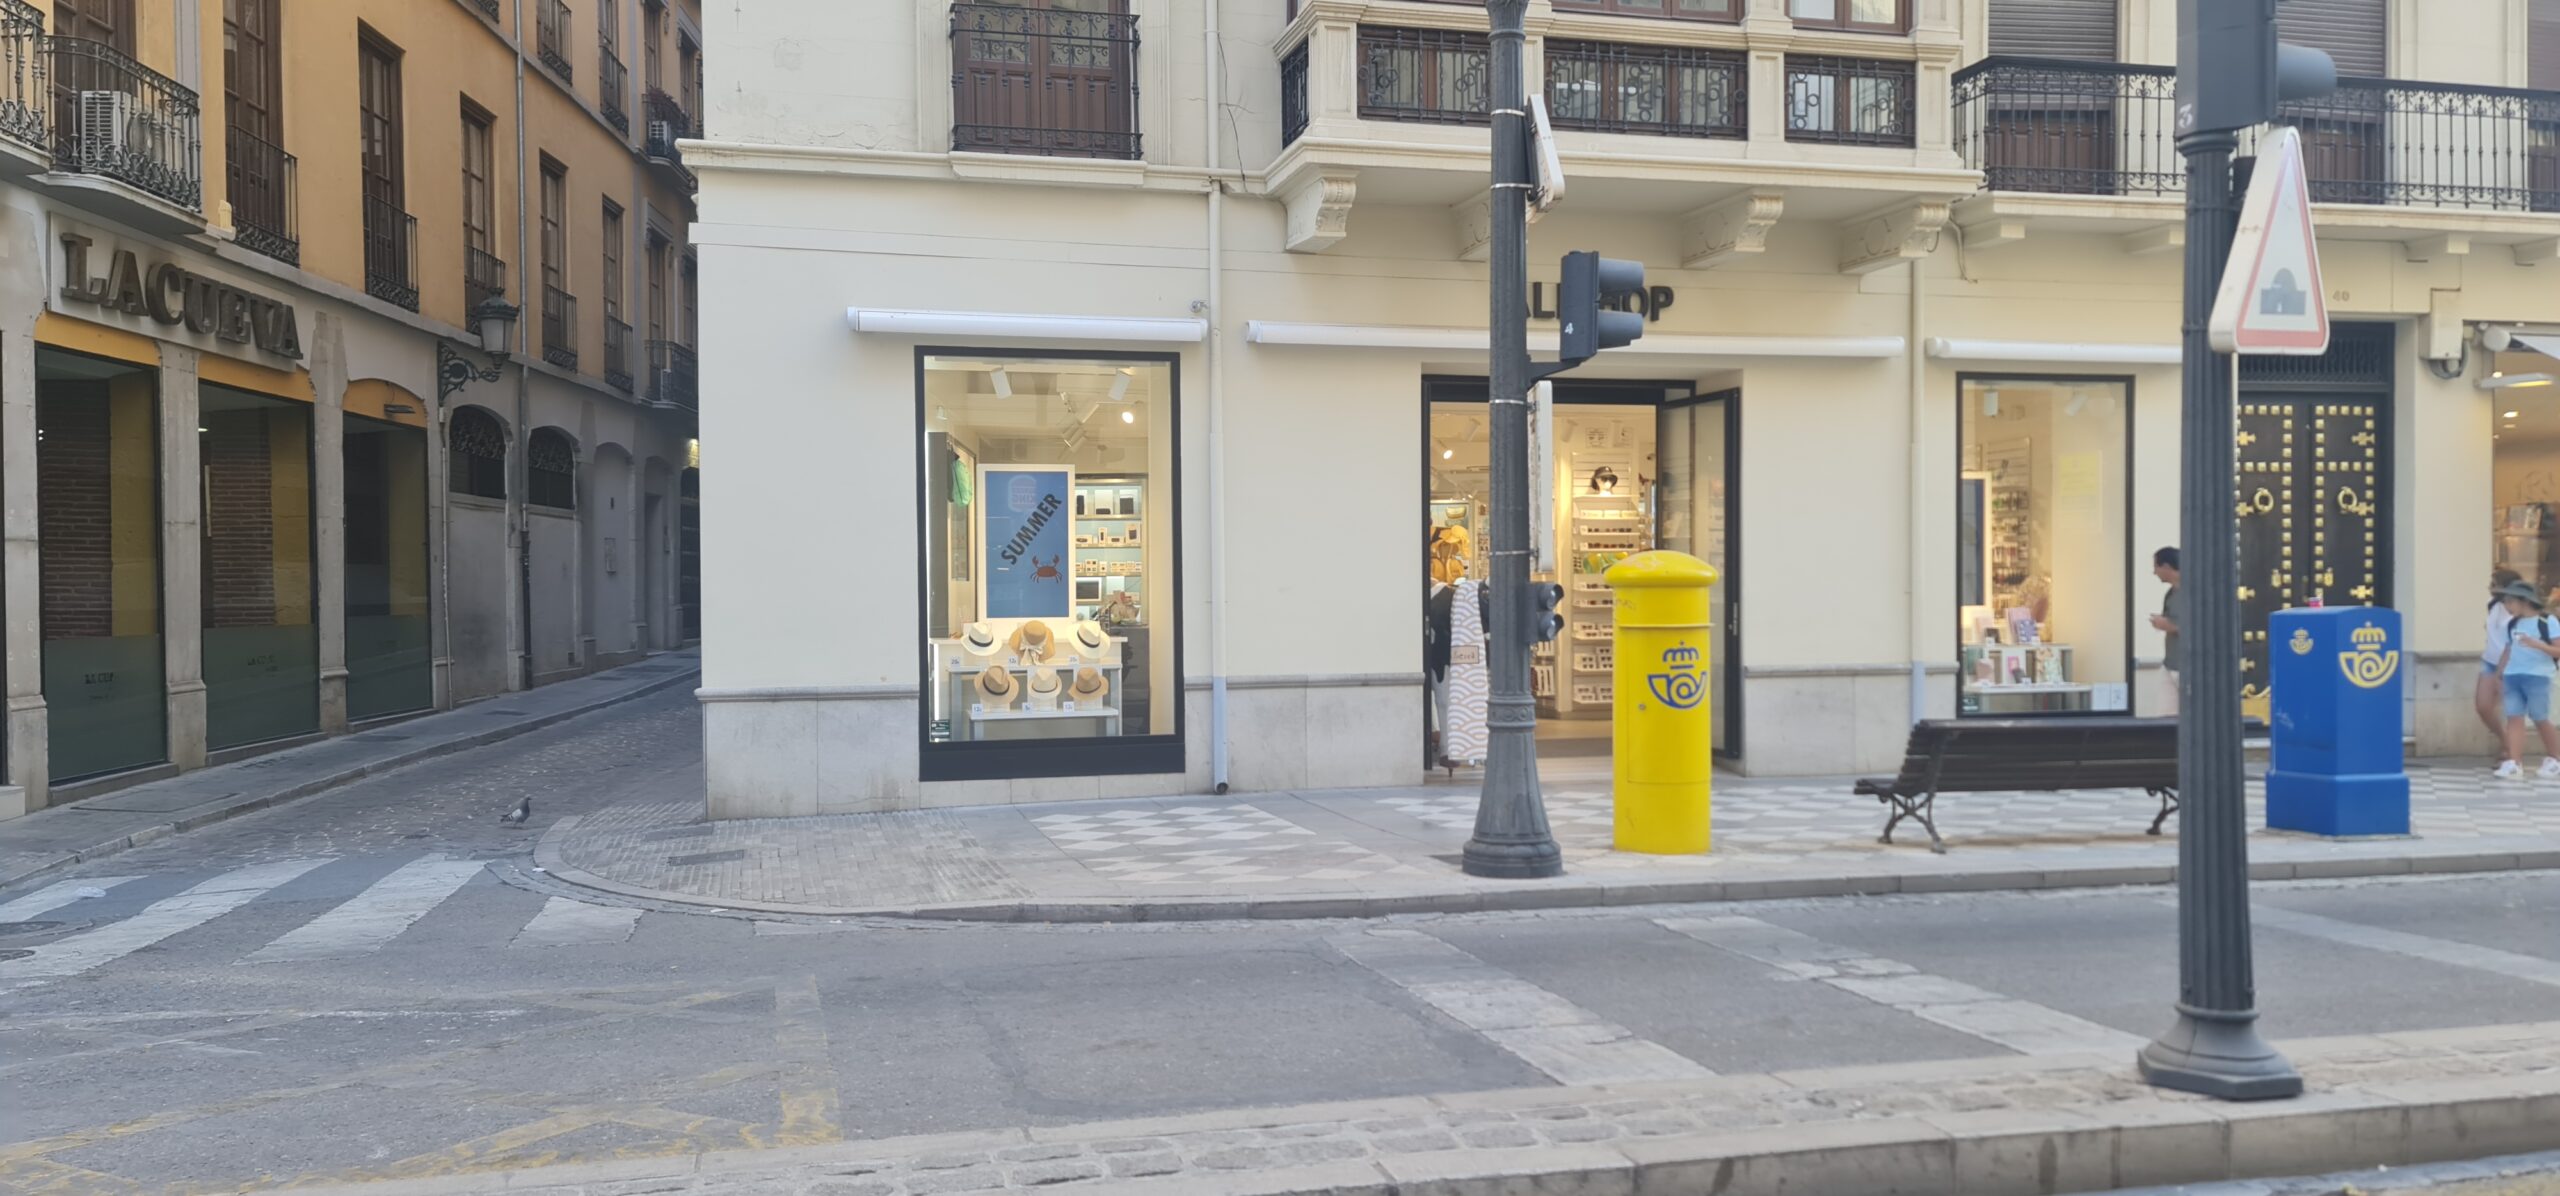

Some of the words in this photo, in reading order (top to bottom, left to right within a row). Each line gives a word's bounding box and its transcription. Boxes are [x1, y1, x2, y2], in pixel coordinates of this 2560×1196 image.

[2179, 103, 2192, 128] 3
[2332, 290, 2350, 302] 40
[1564, 322, 1574, 335] 4
[1001, 493, 1062, 566] SUMMER
